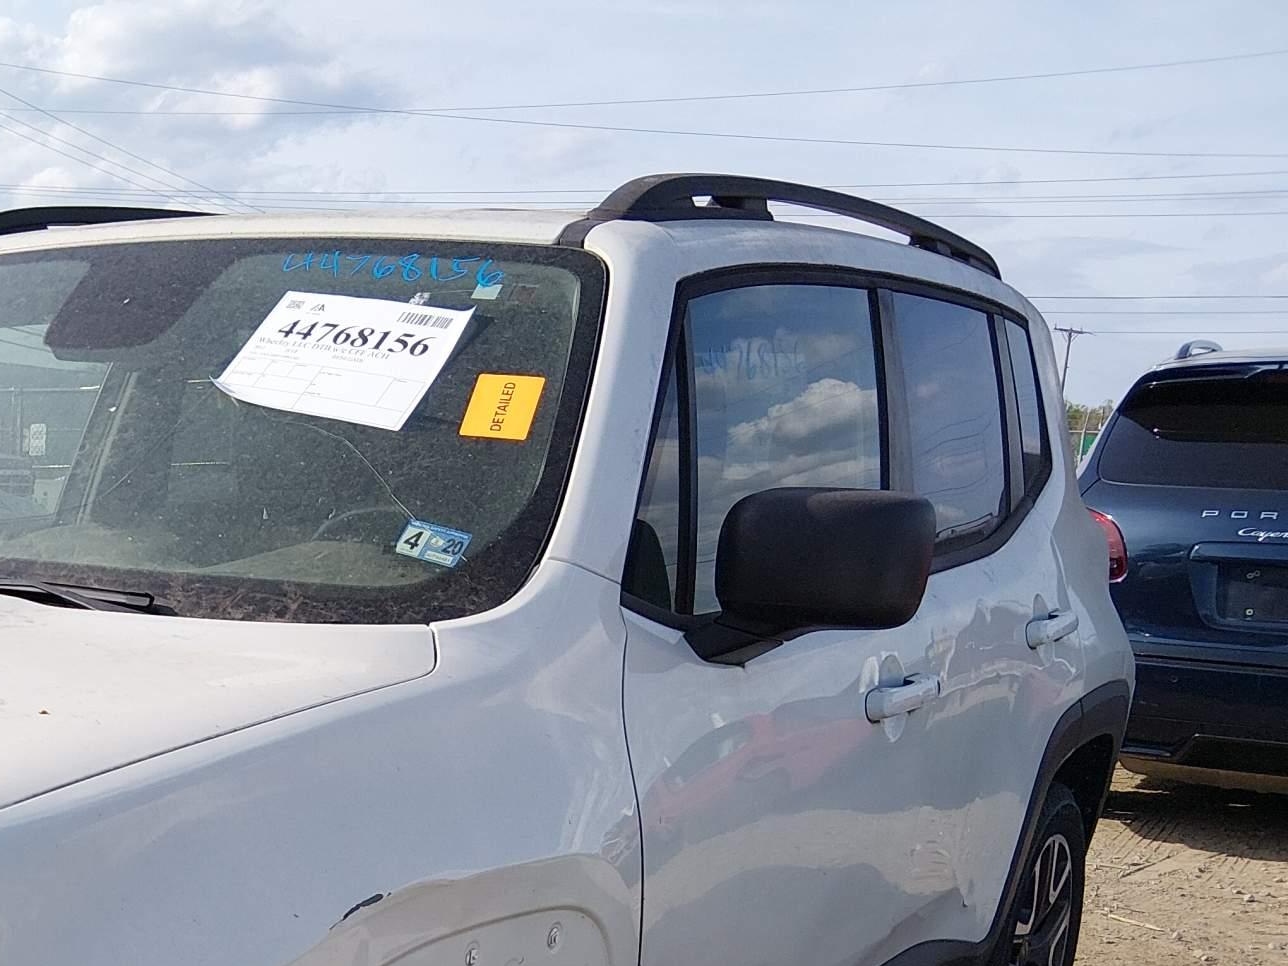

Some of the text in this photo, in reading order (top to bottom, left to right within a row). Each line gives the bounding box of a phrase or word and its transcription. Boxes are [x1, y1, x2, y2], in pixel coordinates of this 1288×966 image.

[282, 251, 504, 287] 44768156
[278, 319, 438, 357] 44768156
[490, 381, 516, 432] DETAILED
[1201, 510, 1279, 519] POR
[403, 531, 424, 550] 4
